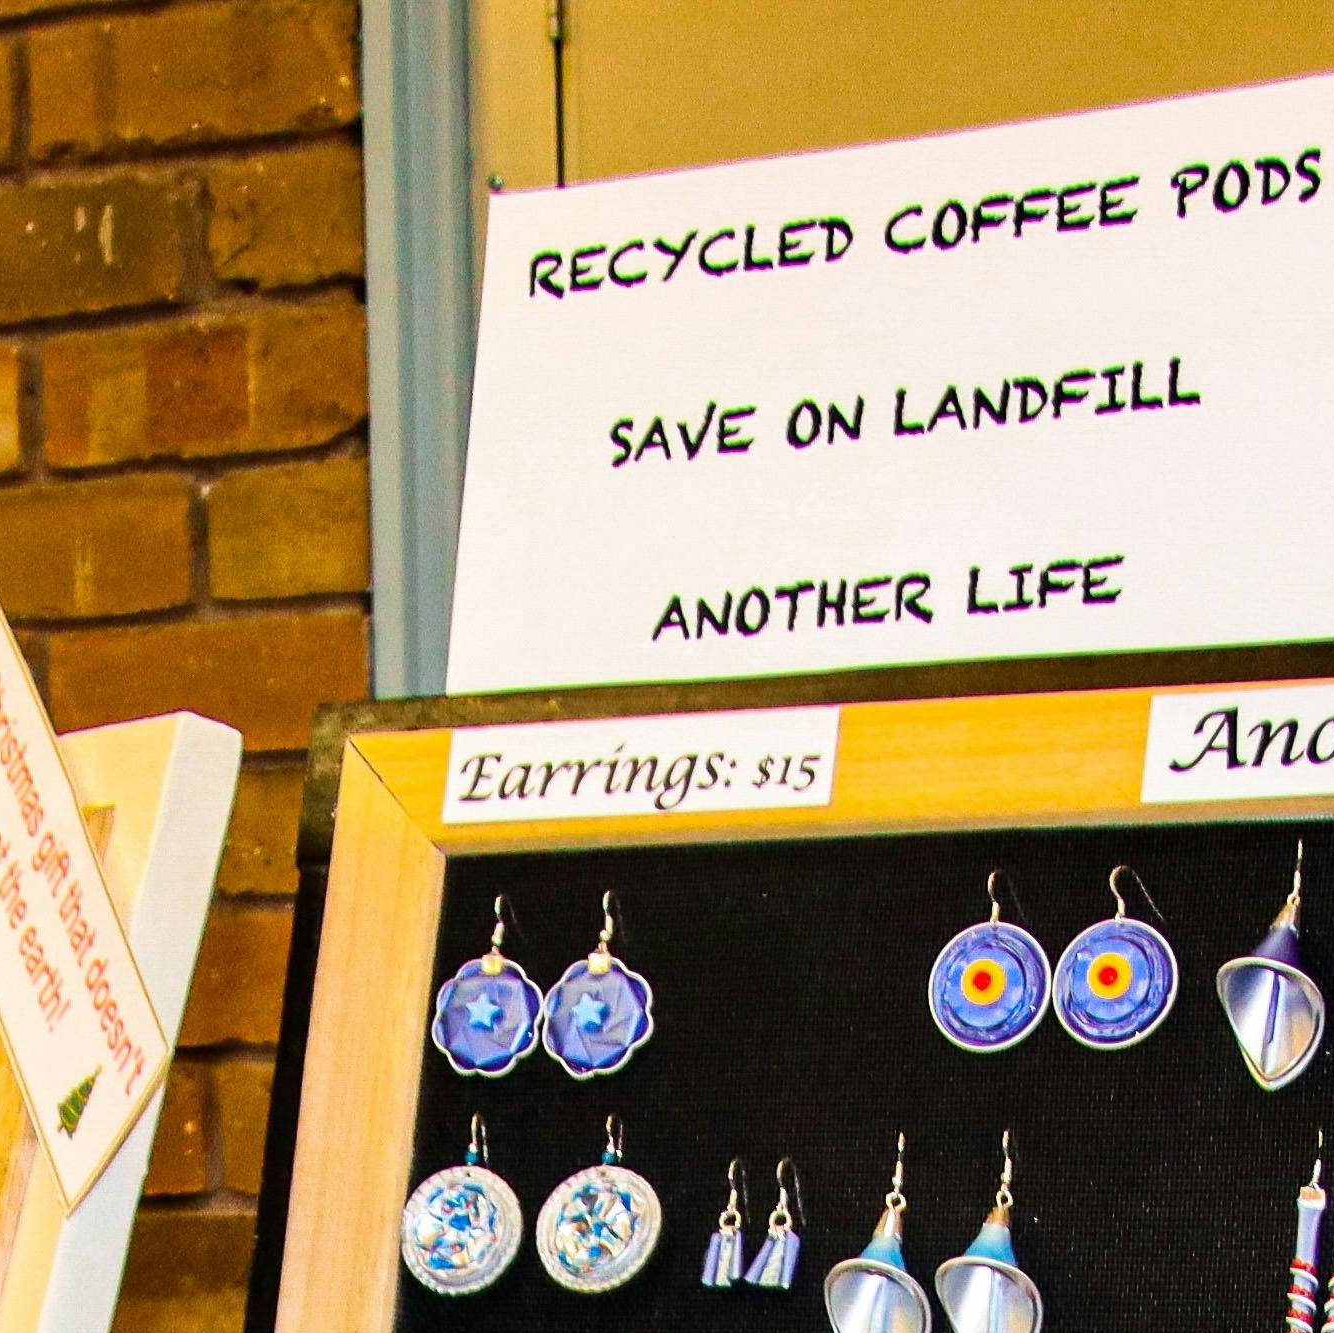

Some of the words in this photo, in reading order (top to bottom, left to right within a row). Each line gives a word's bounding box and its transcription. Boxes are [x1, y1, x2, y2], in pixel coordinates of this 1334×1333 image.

[529, 216, 853, 298] RECYCLED
[885, 176, 1140, 252] COFFEE
[1171, 149, 1322, 217] PODS
[611, 404, 754, 467] SAVE
[786, 396, 864, 449] ON
[894, 358, 1200, 434] LANDFILL
[652, 571, 932, 642] ANOTHER
[967, 555, 1123, 615] LIFE
[460, 744, 736, 809] Earrings:
[752, 752, 819, 790] $15
[20, 930, 70, 1033] earth!
[31, 834, 68, 899] gift
[58, 881, 97, 968] that
[85, 959, 144, 1095] doesn't
